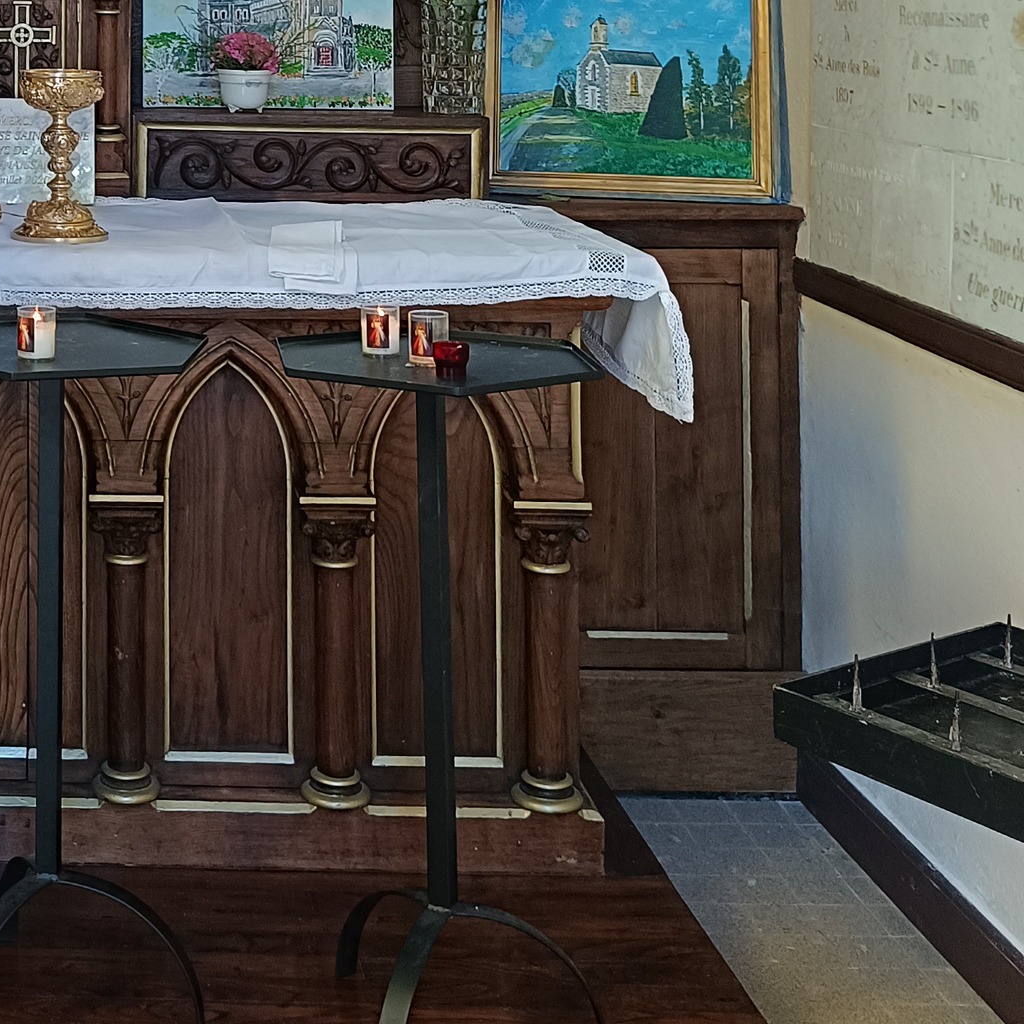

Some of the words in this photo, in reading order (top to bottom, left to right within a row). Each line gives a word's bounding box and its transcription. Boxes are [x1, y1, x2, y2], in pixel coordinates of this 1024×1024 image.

[899, 4, 990, 29] Reconnaissance
[825, 56, 847, 73] Anne
[943, 54, 977, 76] Anne
[13, 130, 41, 141] SAIN
[12, 145, 29, 155] DE
[990, 181, 1024, 211] Merc
[979, 230, 1011, 257] Anne
